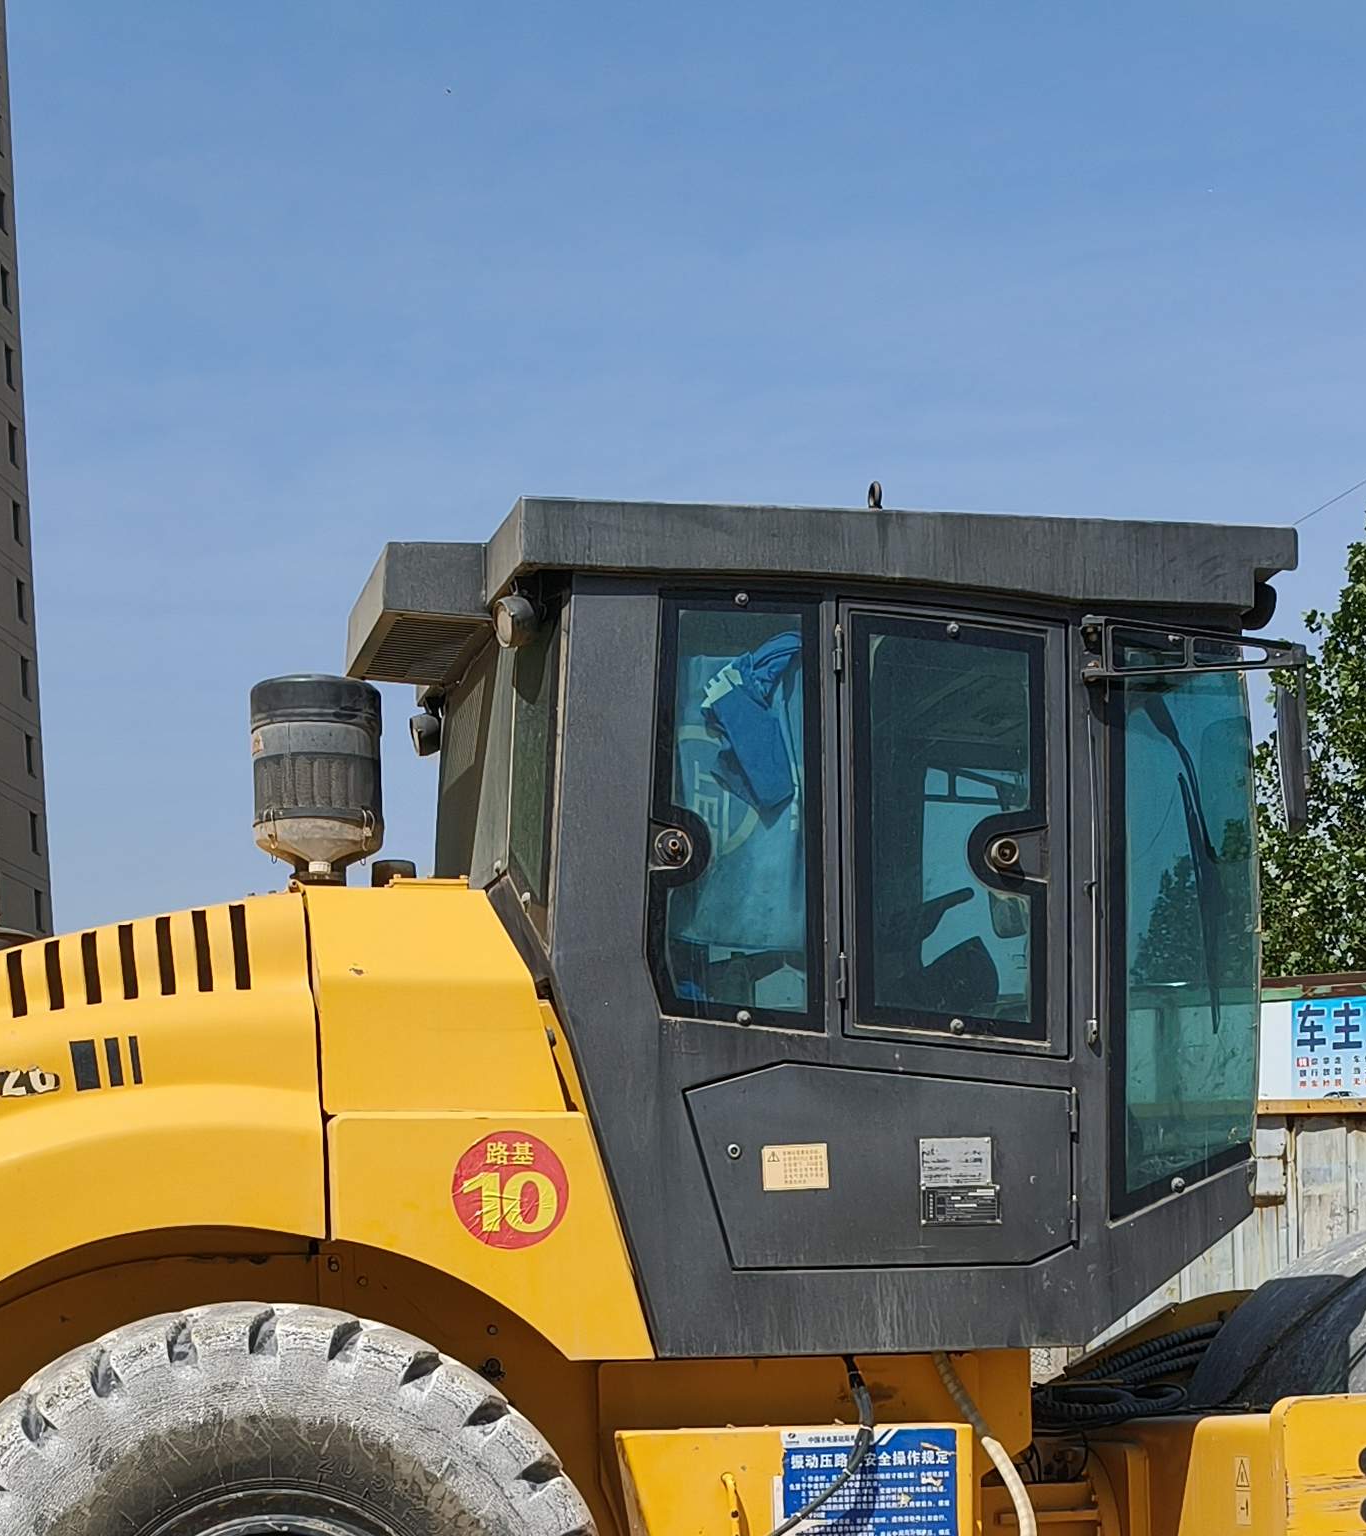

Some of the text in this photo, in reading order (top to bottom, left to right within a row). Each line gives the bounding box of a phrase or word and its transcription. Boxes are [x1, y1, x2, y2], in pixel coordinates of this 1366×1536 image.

[486, 1142, 534, 1165] 路基
[462, 1171, 558, 1233] 10
[791, 1450, 949, 1470] 振动压路安全操作规定
